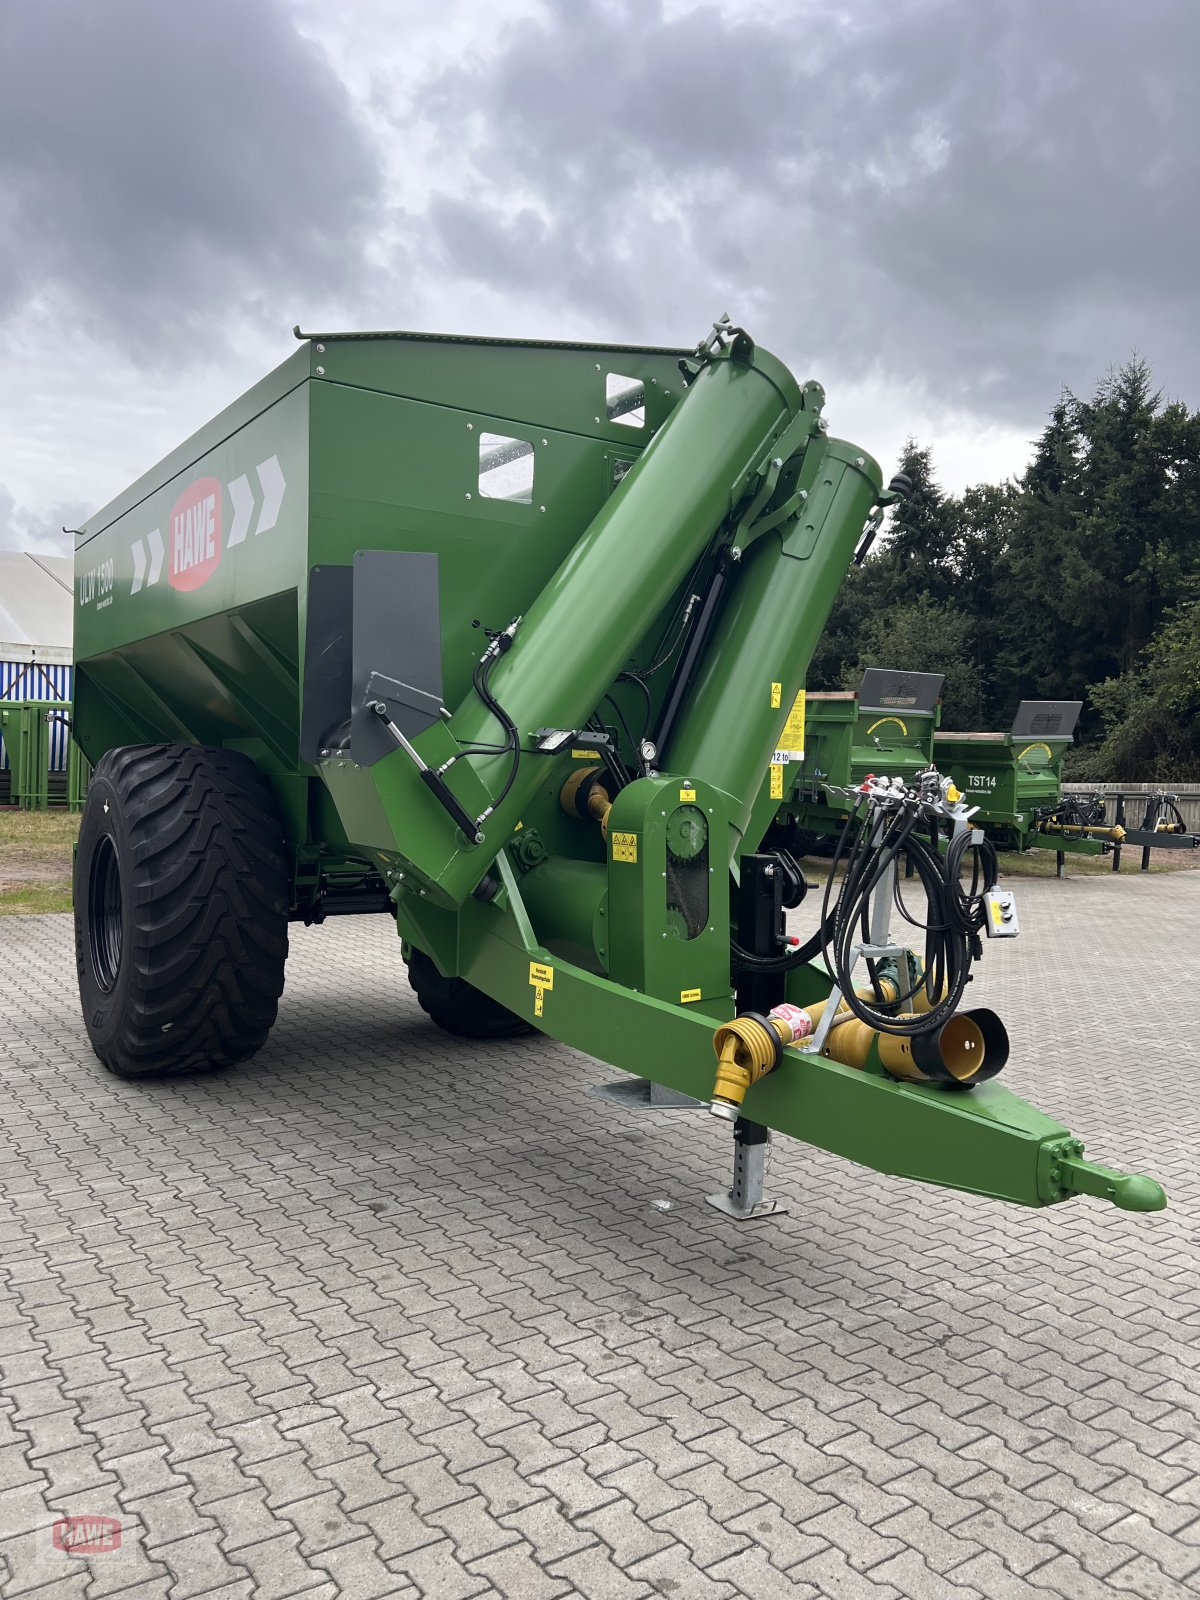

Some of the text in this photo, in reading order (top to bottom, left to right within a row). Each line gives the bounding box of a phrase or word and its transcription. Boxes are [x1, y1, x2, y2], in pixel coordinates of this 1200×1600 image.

[173, 493, 215, 575] HAWE
[79, 557, 114, 606] ULW 1500
[772, 752, 789, 762] 12 to
[968, 775, 997, 788] TST14
